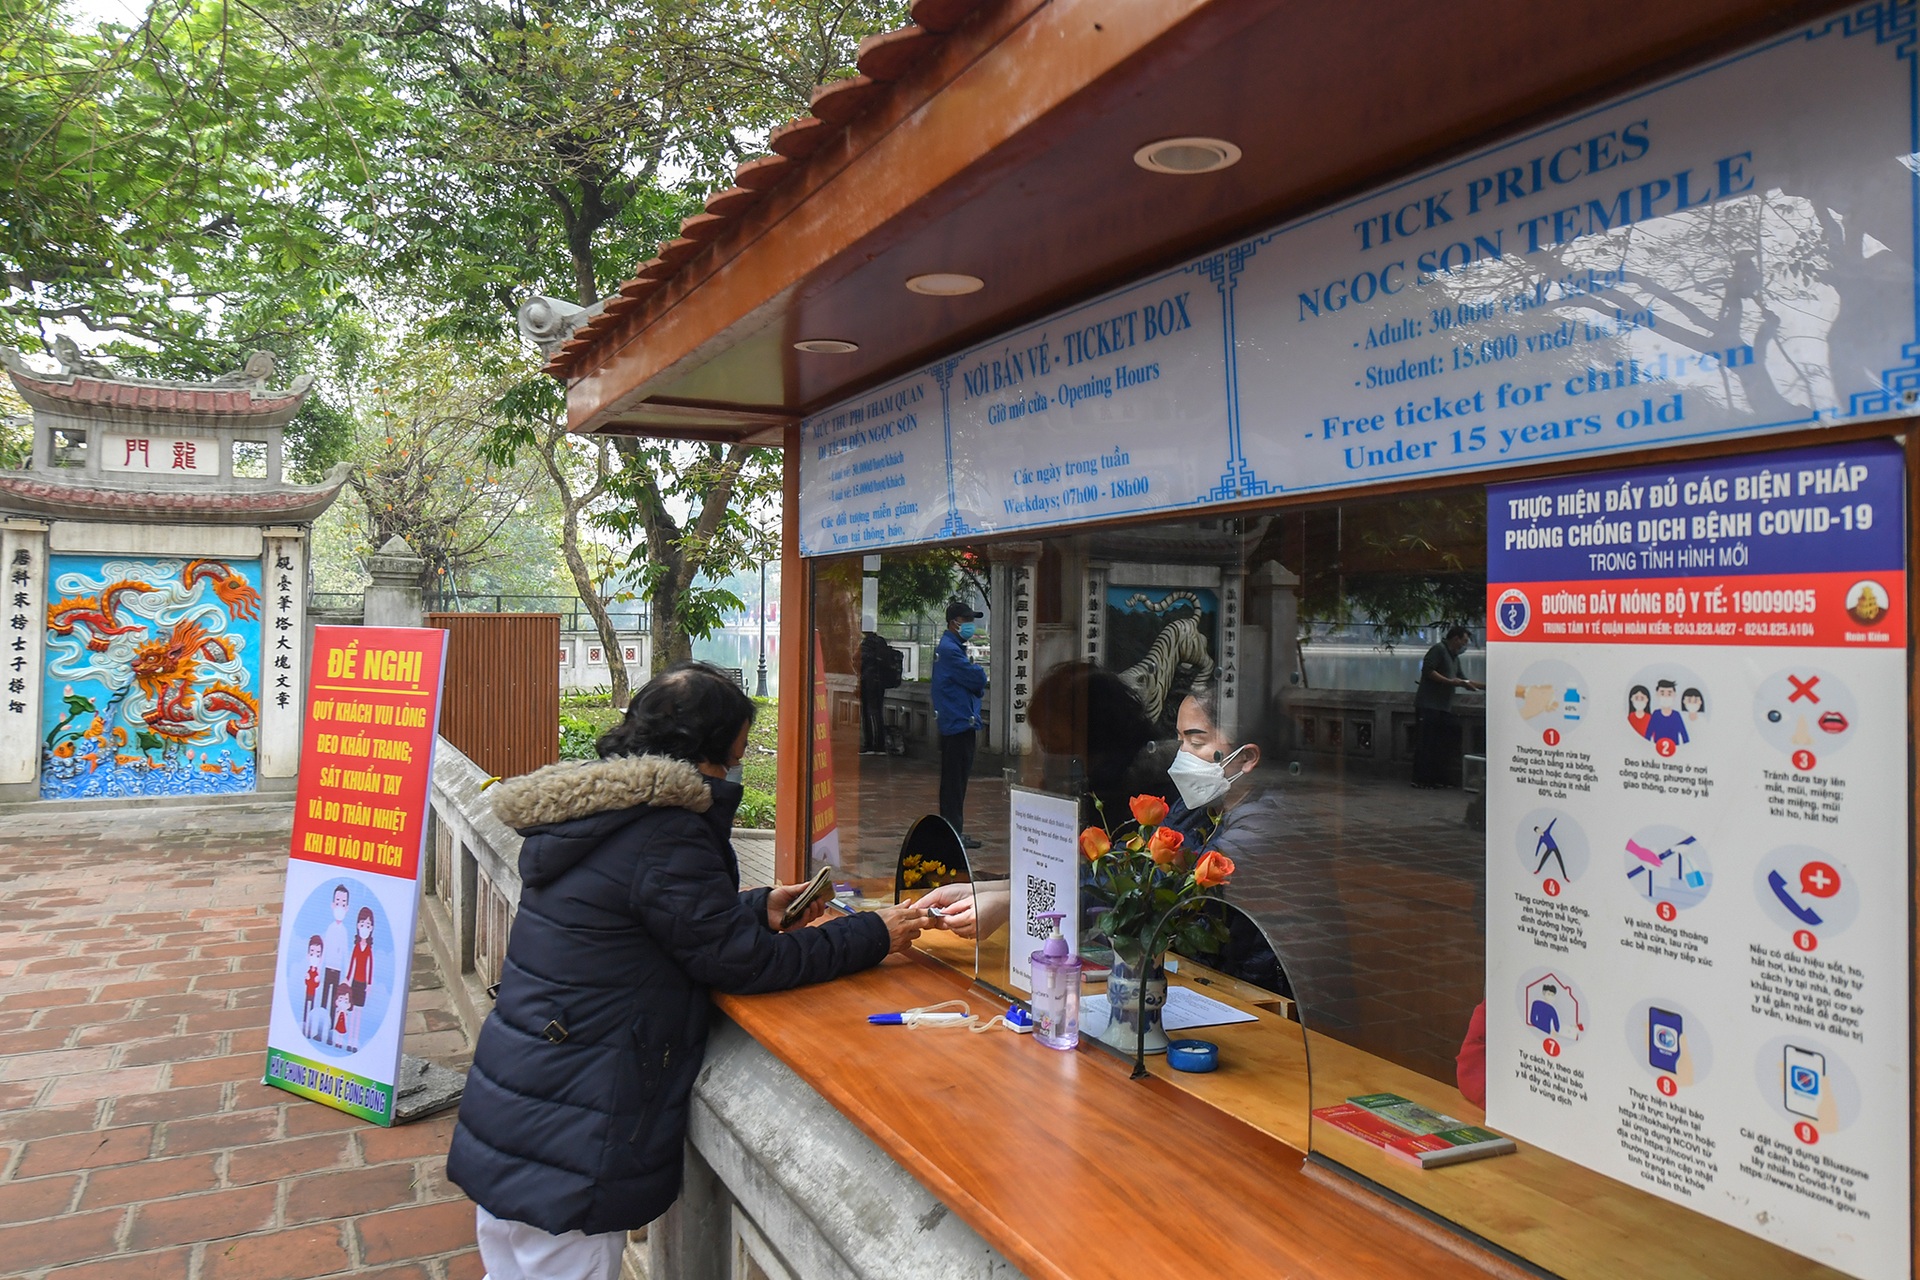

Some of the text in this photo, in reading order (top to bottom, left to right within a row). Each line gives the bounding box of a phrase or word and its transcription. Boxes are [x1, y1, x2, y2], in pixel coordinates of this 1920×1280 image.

[1353, 119, 1650, 252] TICK PRICES
[1297, 151, 1755, 323] NGOC SON TEMPLE
[993, 347, 1024, 391] BÁN
[1028, 333, 1050, 379] VÉ
[1063, 309, 1138, 367] TICKET
[1143, 292, 1192, 342] BOX
[1364, 320, 1422, 351] Adult:
[1428, 301, 1495, 334] 30.000
[1365, 354, 1443, 390] Student:
[1452, 334, 1518, 372] 15.000
[1525, 326, 1575, 355] vnd/
[832, 413, 848, 432] THU
[867, 396, 893, 419] THAM
[895, 383, 925, 412] QUAN
[988, 402, 1006, 426] Giờ
[1028, 391, 1048, 413] cửa
[1058, 374, 1113, 408] Opening
[1115, 361, 1160, 390] Hours
[1321, 344, 1755, 441] Free ticket for children
[868, 421, 895, 444] NGỌC
[1343, 395, 1685, 470] Under 15 years old
[1013, 446, 1130, 486] Các ngày trong tuần
[1004, 476, 1149, 515] Weekdays; 07h00 18h00
[1508, 461, 1868, 524] THỰC HIỆN ĐẦY ĐỦ CÁC BIỆN PHÁP
[821, 514, 833, 529] Các
[833, 530, 848, 545] Xem
[863, 524, 885, 541] thông
[1505, 504, 1873, 551] PHÒNG CHỐNG DỊCH BỆNH COVID-19
[1589, 543, 1750, 572] TRONG TÌNH HÌNH MỚI
[1542, 587, 1587, 615] ĐƯỜNG
[1590, 589, 1617, 614] DÂY
[1620, 587, 1662, 614] NÓNG
[1665, 588, 1687, 618] BỘ
[1689, 592, 1701, 614] Y
[1704, 584, 1727, 614] TẾ:
[1732, 589, 1817, 614] 19009095
[1542, 622, 1566, 635] TRUNG
[1584, 623, 1590, 634] Y
[327, 639, 423, 689] ĐỀ NGHỊ
[313, 698, 426, 727] QUÝ KHÁCH VUI LÒNG
[317, 730, 413, 764] ĐEO KHẨU TRANG;
[1549, 731, 1554, 744] 1
[1662, 740, 1670, 755] 2
[1662, 763, 1683, 773] trang
[1799, 752, 1808, 769] 3
[320, 764, 402, 795] SÁT KHUẨN TAY
[309, 796, 407, 835] VÀ ĐO THÂN NHIỆT
[304, 832, 403, 868] KHI ĐI VÀO DI TÍCH
[1549, 880, 1556, 895] 4
[1662, 904, 1670, 919] 5
[1549, 1040, 1555, 1055] 7
[307, 1068, 319, 1090] TAY
[1663, 1079, 1671, 1093] 8
